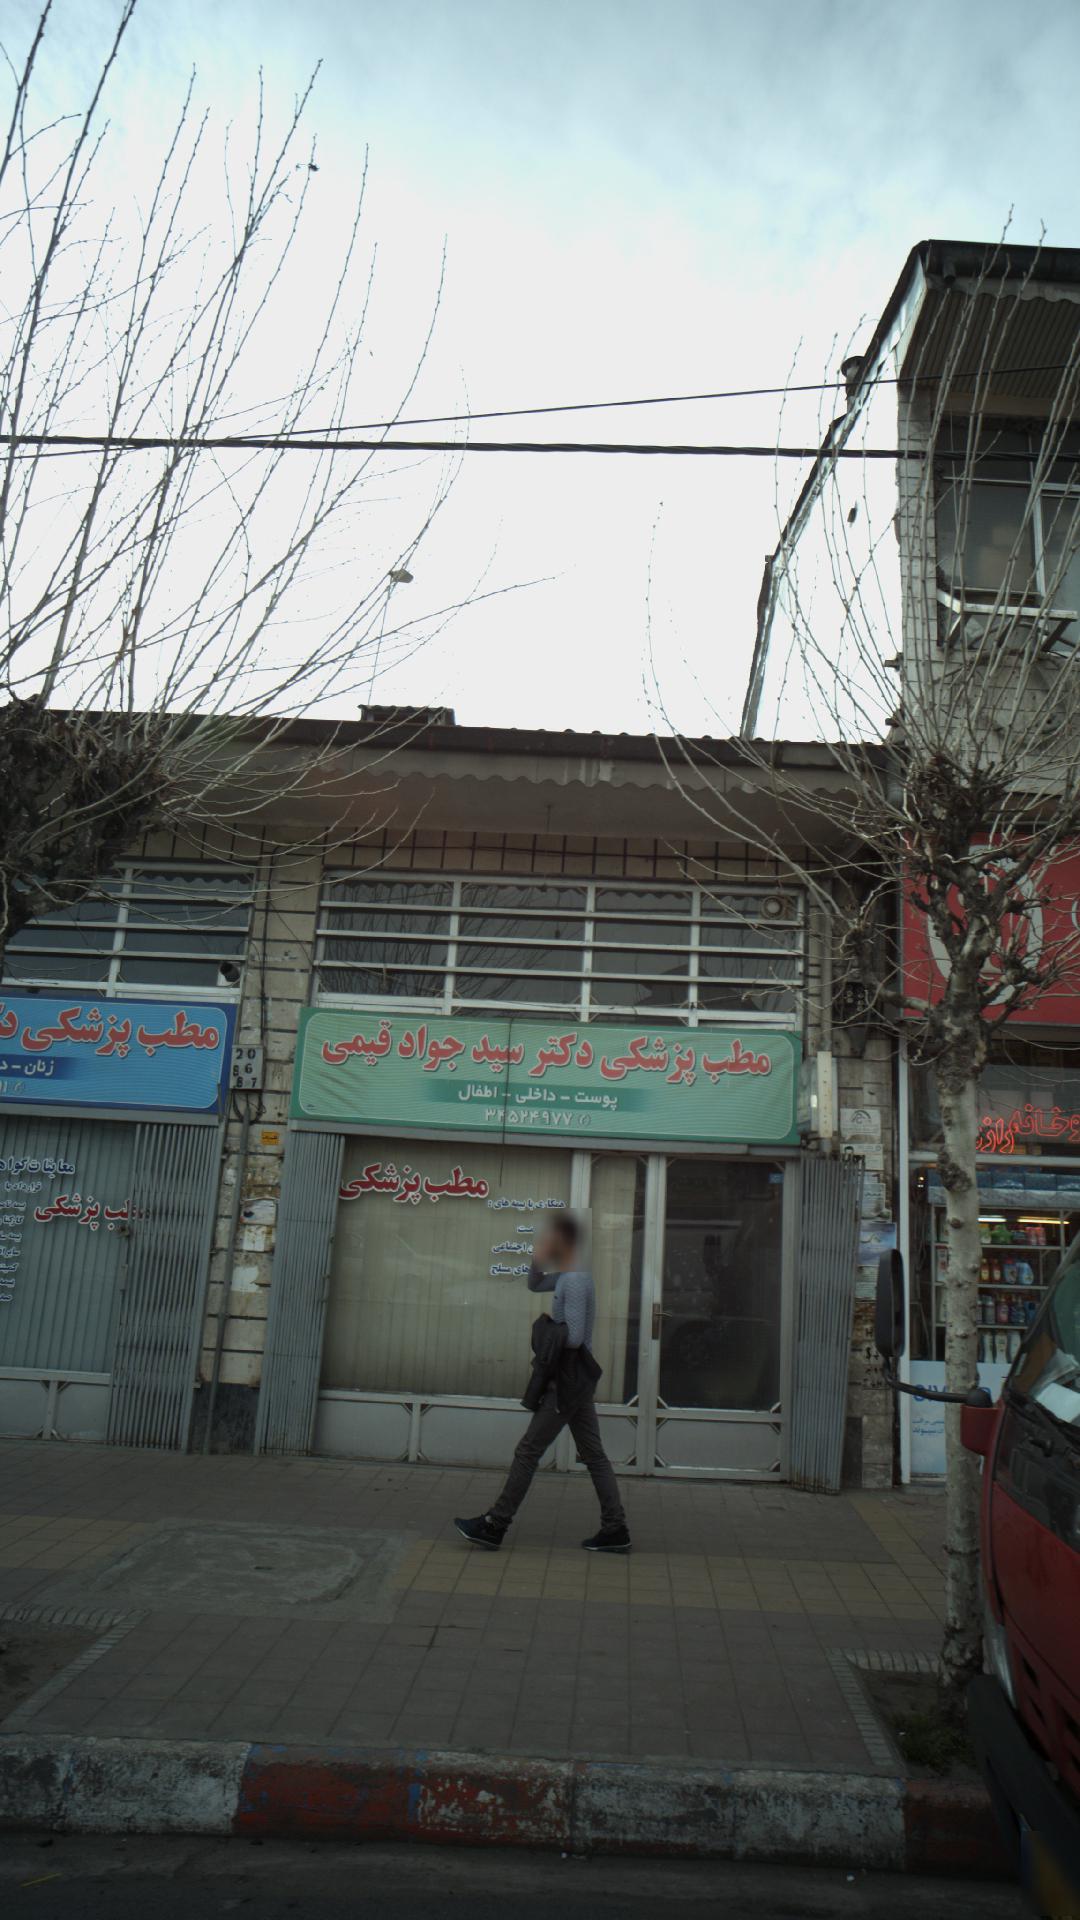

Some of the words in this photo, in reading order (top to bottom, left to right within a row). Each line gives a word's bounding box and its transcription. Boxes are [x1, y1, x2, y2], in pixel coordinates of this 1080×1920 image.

[21, 1007, 132, 1058] پزشکی
[138, 1009, 220, 1057] مطب
[322, 1019, 392, 1065] قیمی
[397, 1023, 466, 1071] جواد
[471, 1034, 525, 1072] سید
[24, 1059, 55, 1076] زنان
[528, 1032, 594, 1077] دکتر
[599, 1036, 697, 1086] پزشکی
[702, 1038, 772, 1083] مطب
[458, 1085, 498, 1101] اطفال
[515, 1088, 556, 1104] داخلی
[574, 1091, 618, 1111] پوست
[339, 1162, 422, 1205] پزشکی
[424, 1165, 490, 1203] مطب
[34, 1193, 100, 1230] پزشکی
